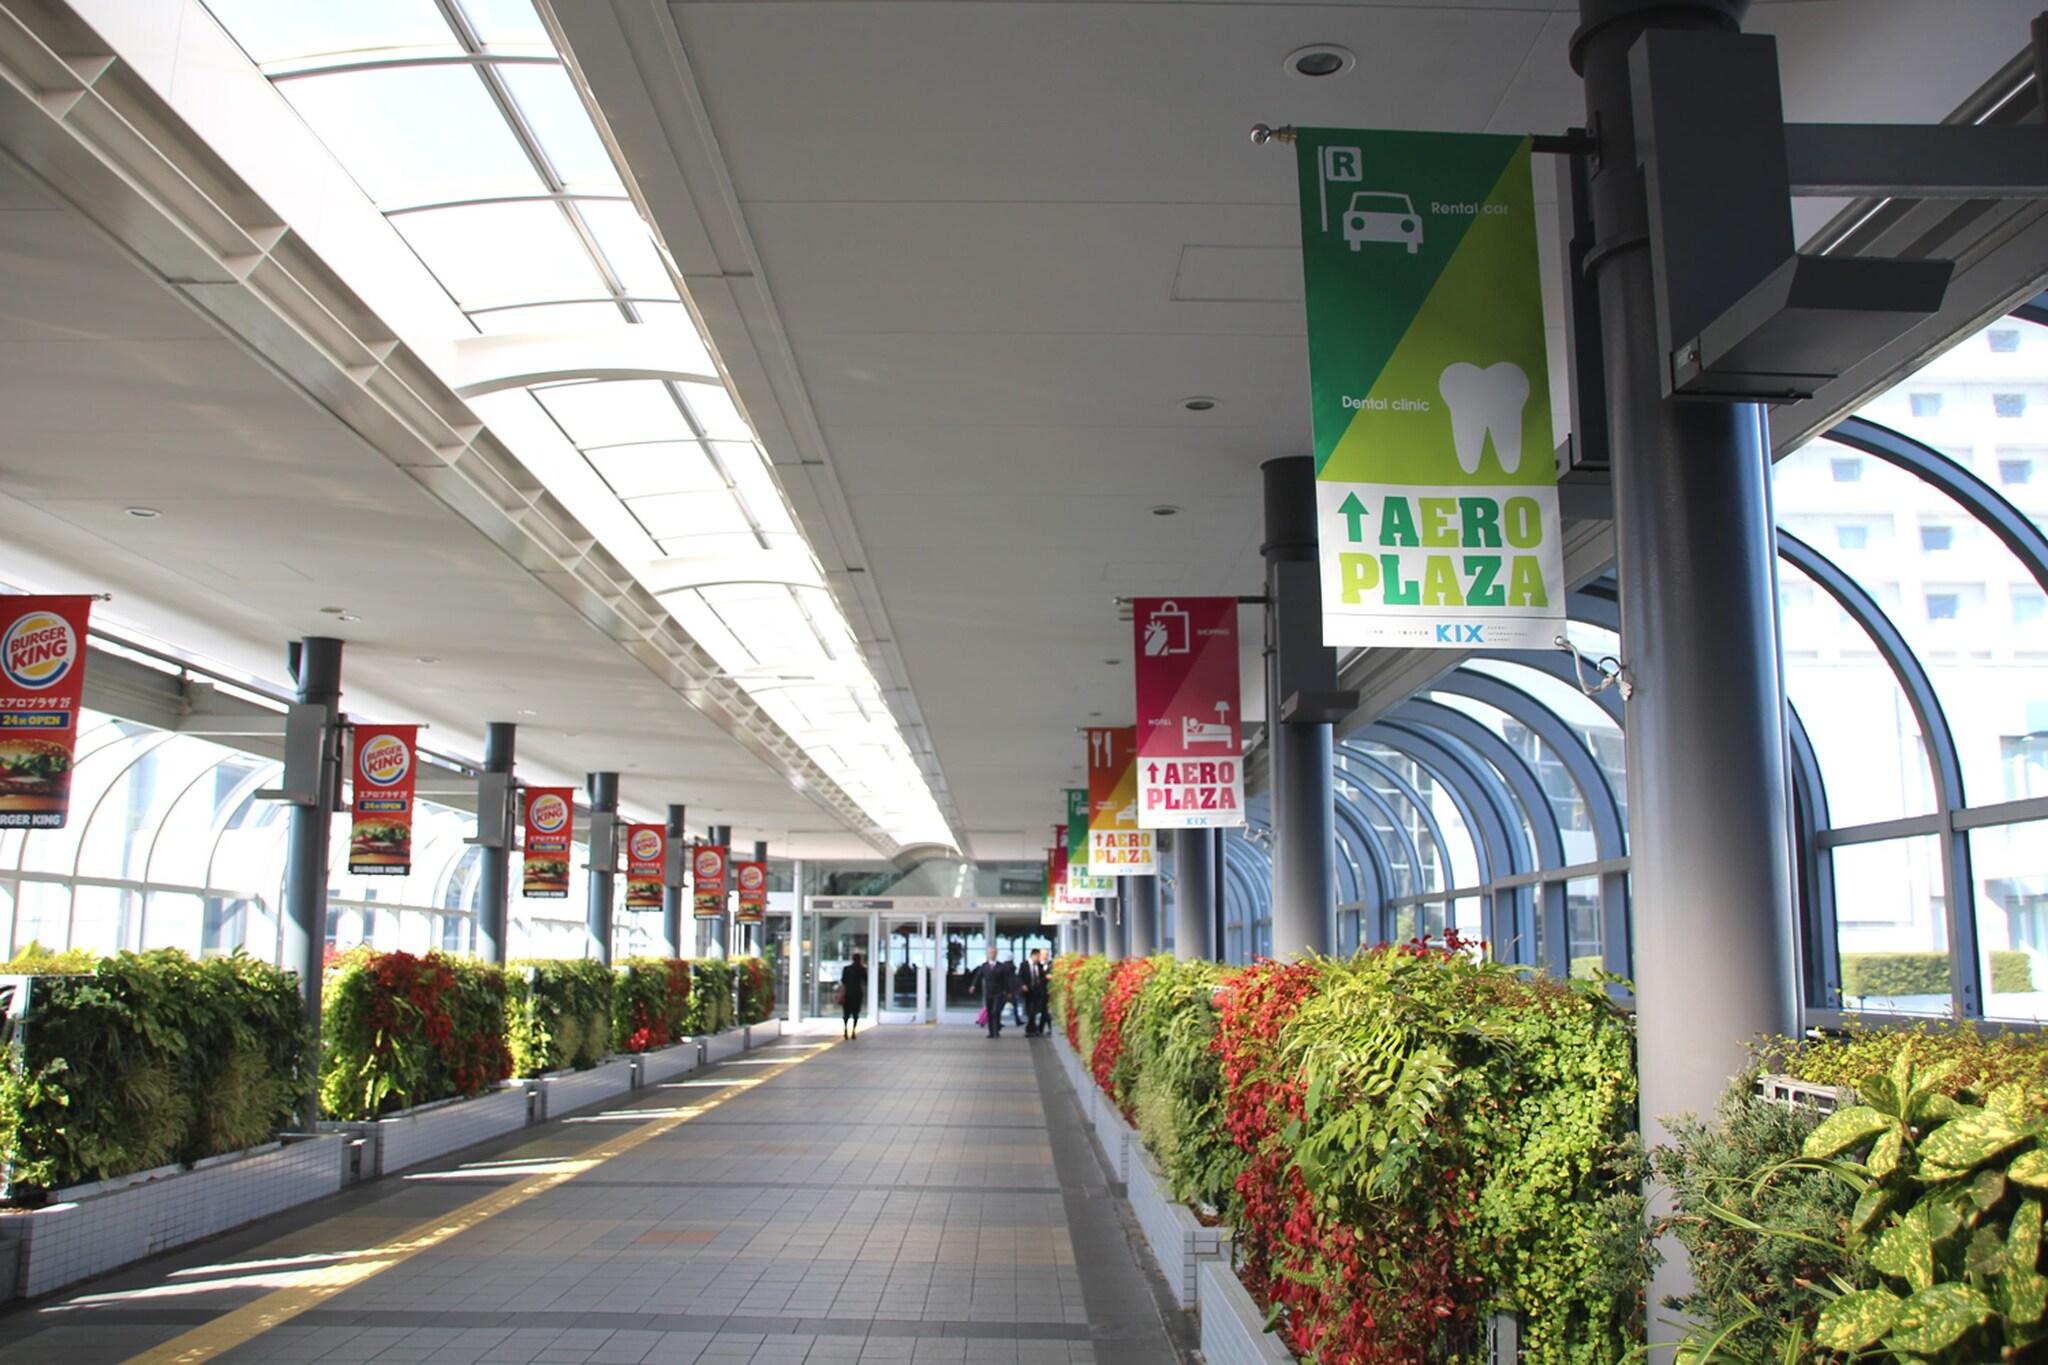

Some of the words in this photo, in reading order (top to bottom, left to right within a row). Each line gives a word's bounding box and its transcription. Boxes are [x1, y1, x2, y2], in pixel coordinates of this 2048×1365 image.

[1332, 151, 1357, 177] R
[1431, 201, 1479, 215] Rental
[1483, 203, 1509, 215] car
[1341, 395, 1388, 410] Dental
[1391, 398, 1431, 412] clinic
[1378, 495, 1544, 549] AERO
[1339, 551, 1549, 608] PLAZA
[10, 625, 66, 653] BURGER
[1435, 623, 1485, 643] KIX
[11, 638, 68, 673] KING
[28, 715, 61, 726] OPEN
[367, 745, 402, 759] BURGER
[368, 753, 403, 774] KING
[1164, 761, 1235, 785] AERO
[1146, 787, 1237, 811] PLAZA
[0, 814, 31, 825] RGER
[32, 814, 60, 825] KING
[1105, 832, 1151, 848] AERO
[1094, 849, 1152, 864] PLAZA
[1071, 878, 1114, 889] PLAZA
